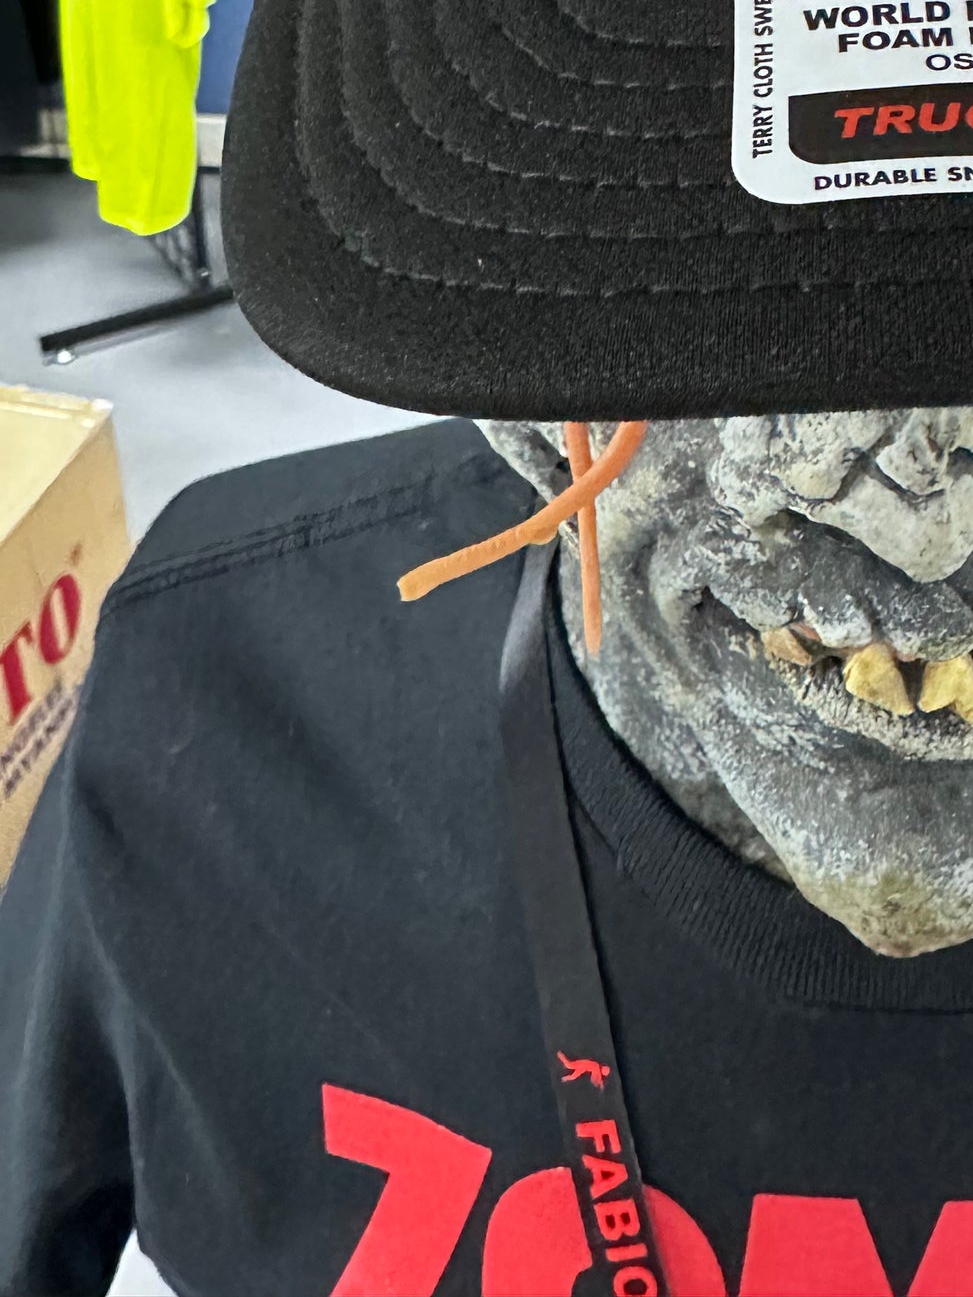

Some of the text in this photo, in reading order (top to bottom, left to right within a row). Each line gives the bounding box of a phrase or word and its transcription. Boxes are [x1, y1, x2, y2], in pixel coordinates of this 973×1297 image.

[803, 1, 951, 25] WORLD
[838, 27, 954, 53] FOAM
[752, 43, 774, 98] CLOTH
[752, 104, 774, 159] TERRY
[814, 165, 938, 191] DURABLE
